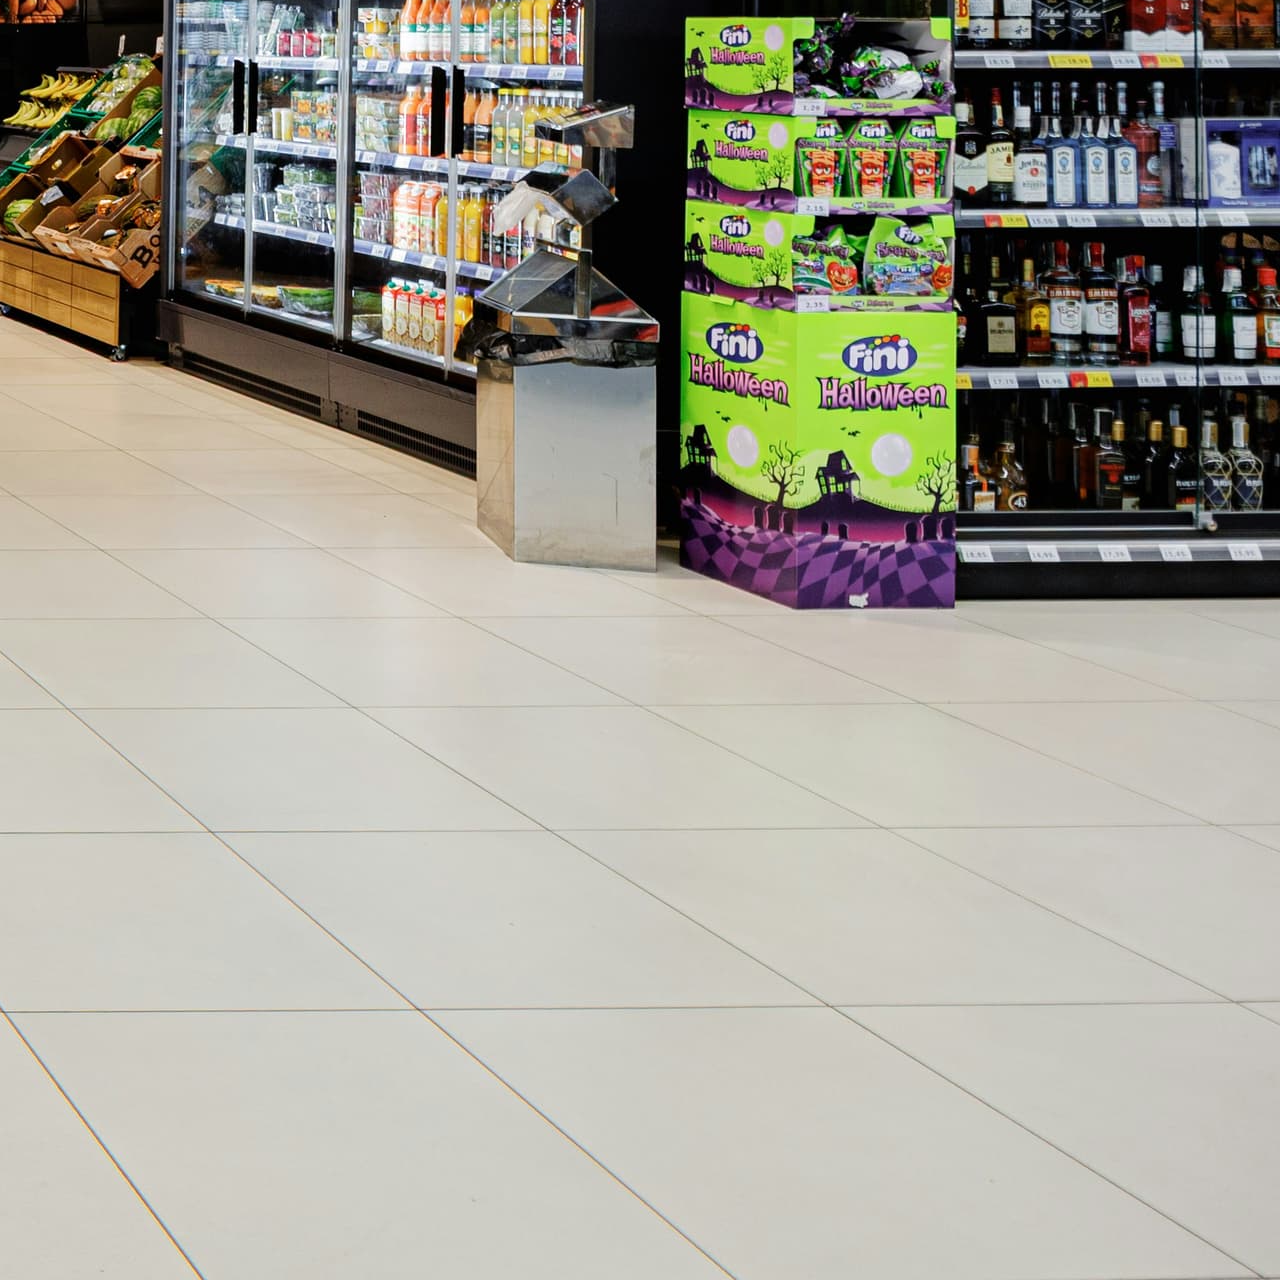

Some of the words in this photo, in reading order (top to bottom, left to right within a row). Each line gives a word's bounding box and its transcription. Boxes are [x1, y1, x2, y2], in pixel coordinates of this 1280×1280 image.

[710, 48, 765, 65] Halloween
[714, 140, 768, 162] Halloween
[710, 235, 765, 259] Halloween
[710, 328, 757, 361] Fini
[848, 338, 909, 372] Fini
[688, 353, 790, 407] Halloween
[817, 377, 950, 411] Halloween
